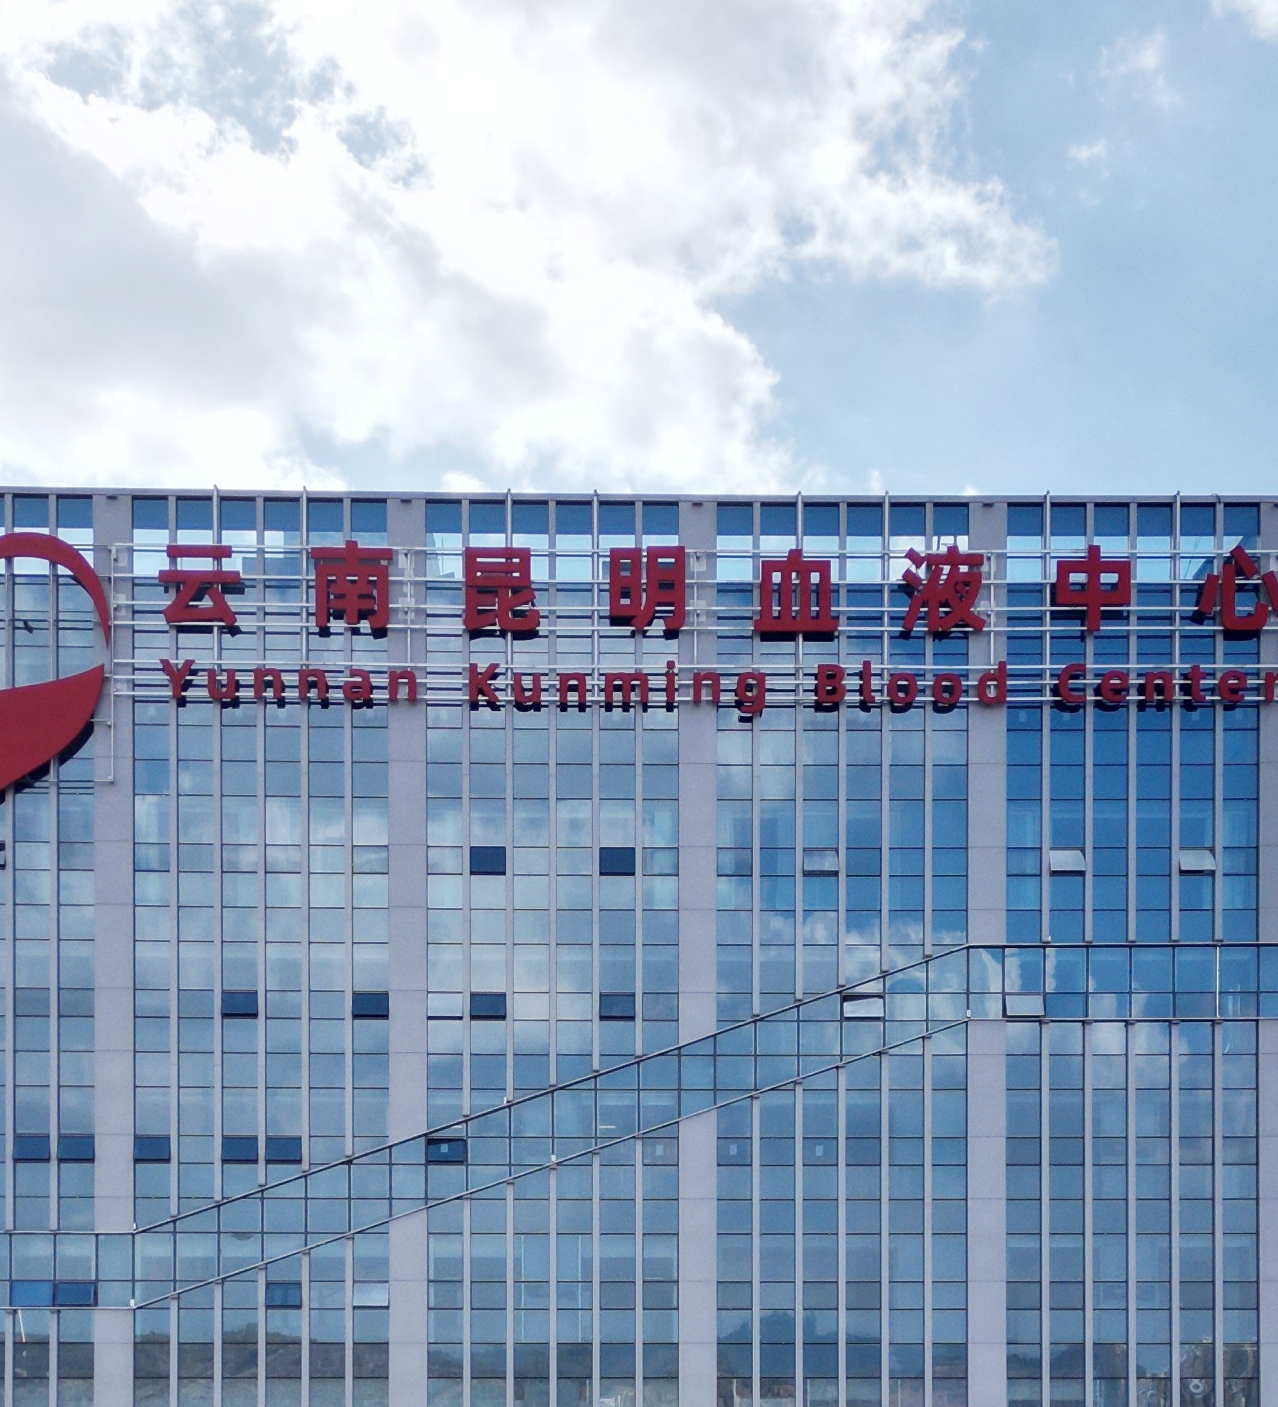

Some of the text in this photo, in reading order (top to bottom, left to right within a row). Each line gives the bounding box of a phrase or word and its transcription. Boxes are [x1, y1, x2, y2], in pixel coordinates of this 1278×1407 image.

[159, 659, 417, 702] Yunnan
[469, 661, 766, 714] Kunming
[817, 660, 1007, 704] Blood
